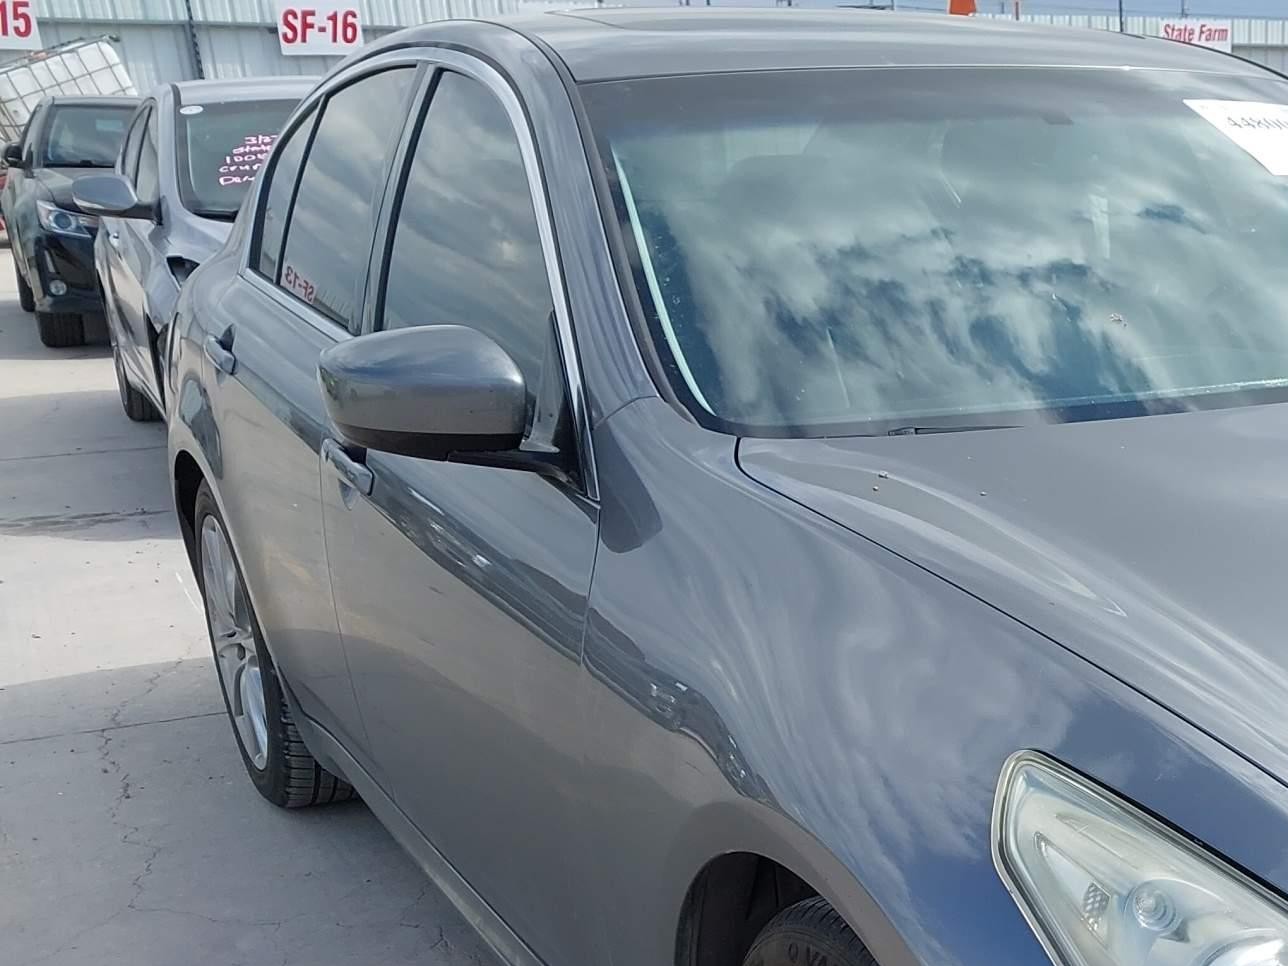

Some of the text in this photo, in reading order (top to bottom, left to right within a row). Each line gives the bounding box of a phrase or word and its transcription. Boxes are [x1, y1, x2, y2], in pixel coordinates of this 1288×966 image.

[282, 9, 358, 44] SF-16
[1163, 23, 1229, 42] State Farm
